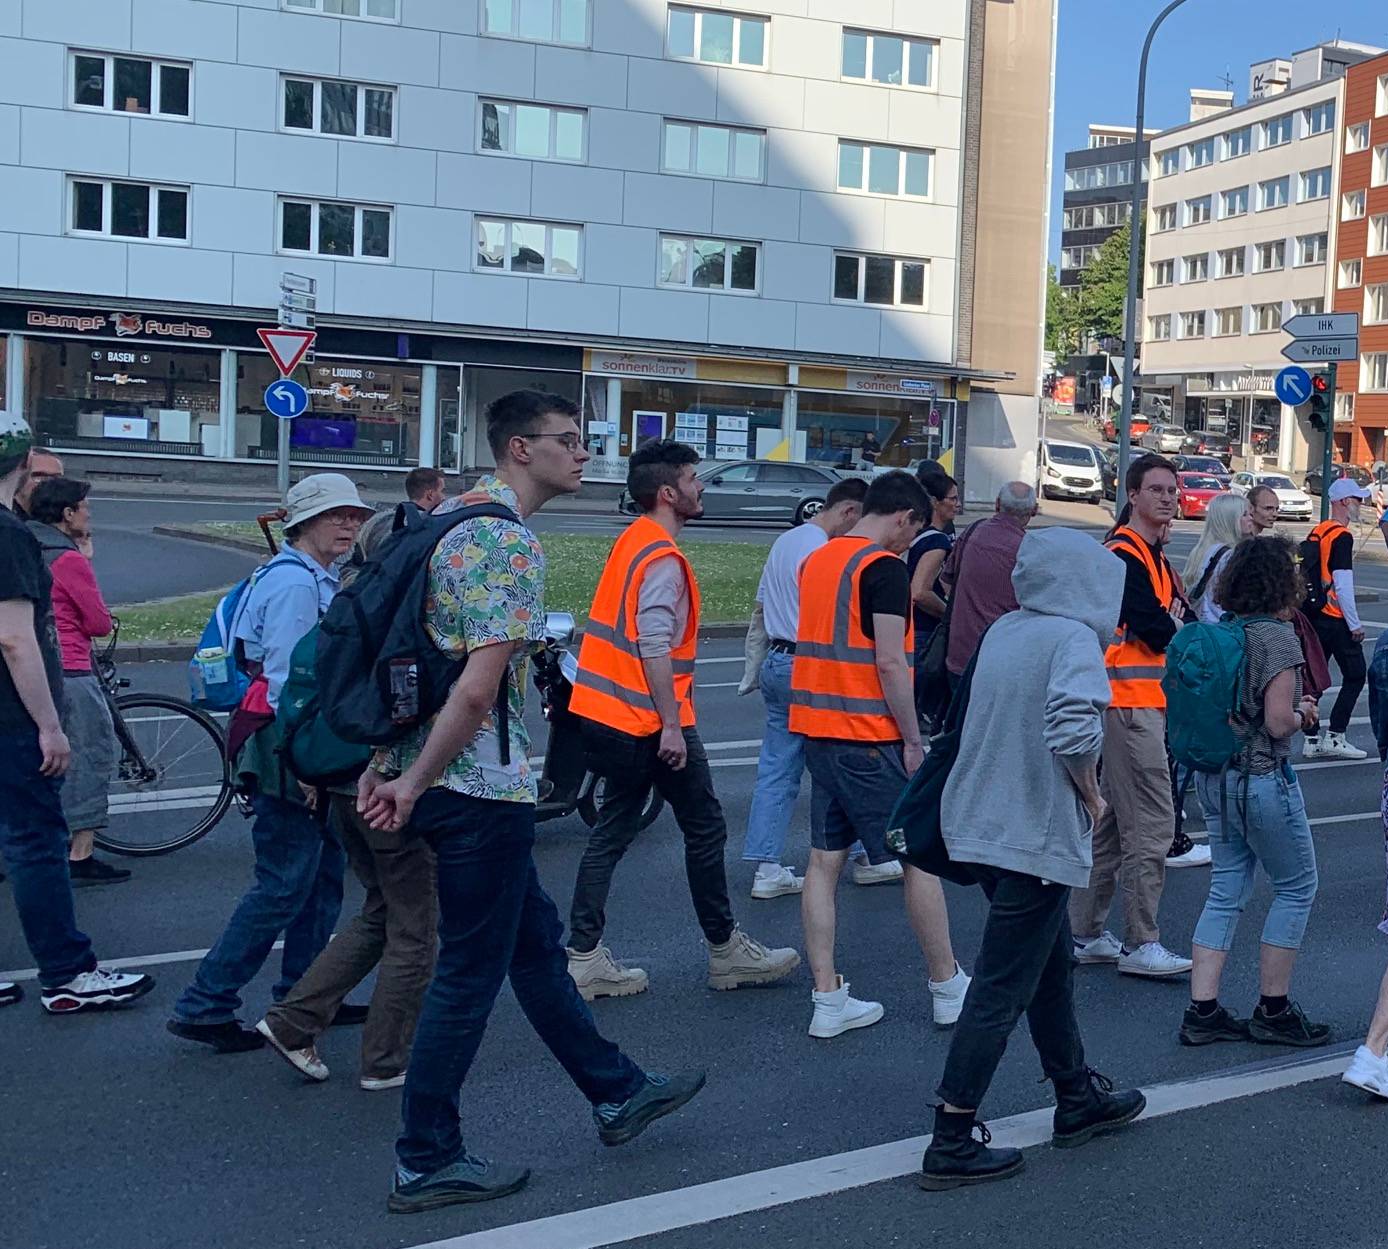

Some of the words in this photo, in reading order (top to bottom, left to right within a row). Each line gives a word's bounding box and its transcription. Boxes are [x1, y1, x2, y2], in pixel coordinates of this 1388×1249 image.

[1318, 319, 1334, 331] IHK
[1311, 344, 1341, 356] Polizei
[107, 352, 135, 363] BASEN
[331, 367, 362, 379] LIQUIDS
[305, 387, 336, 396] ampf
